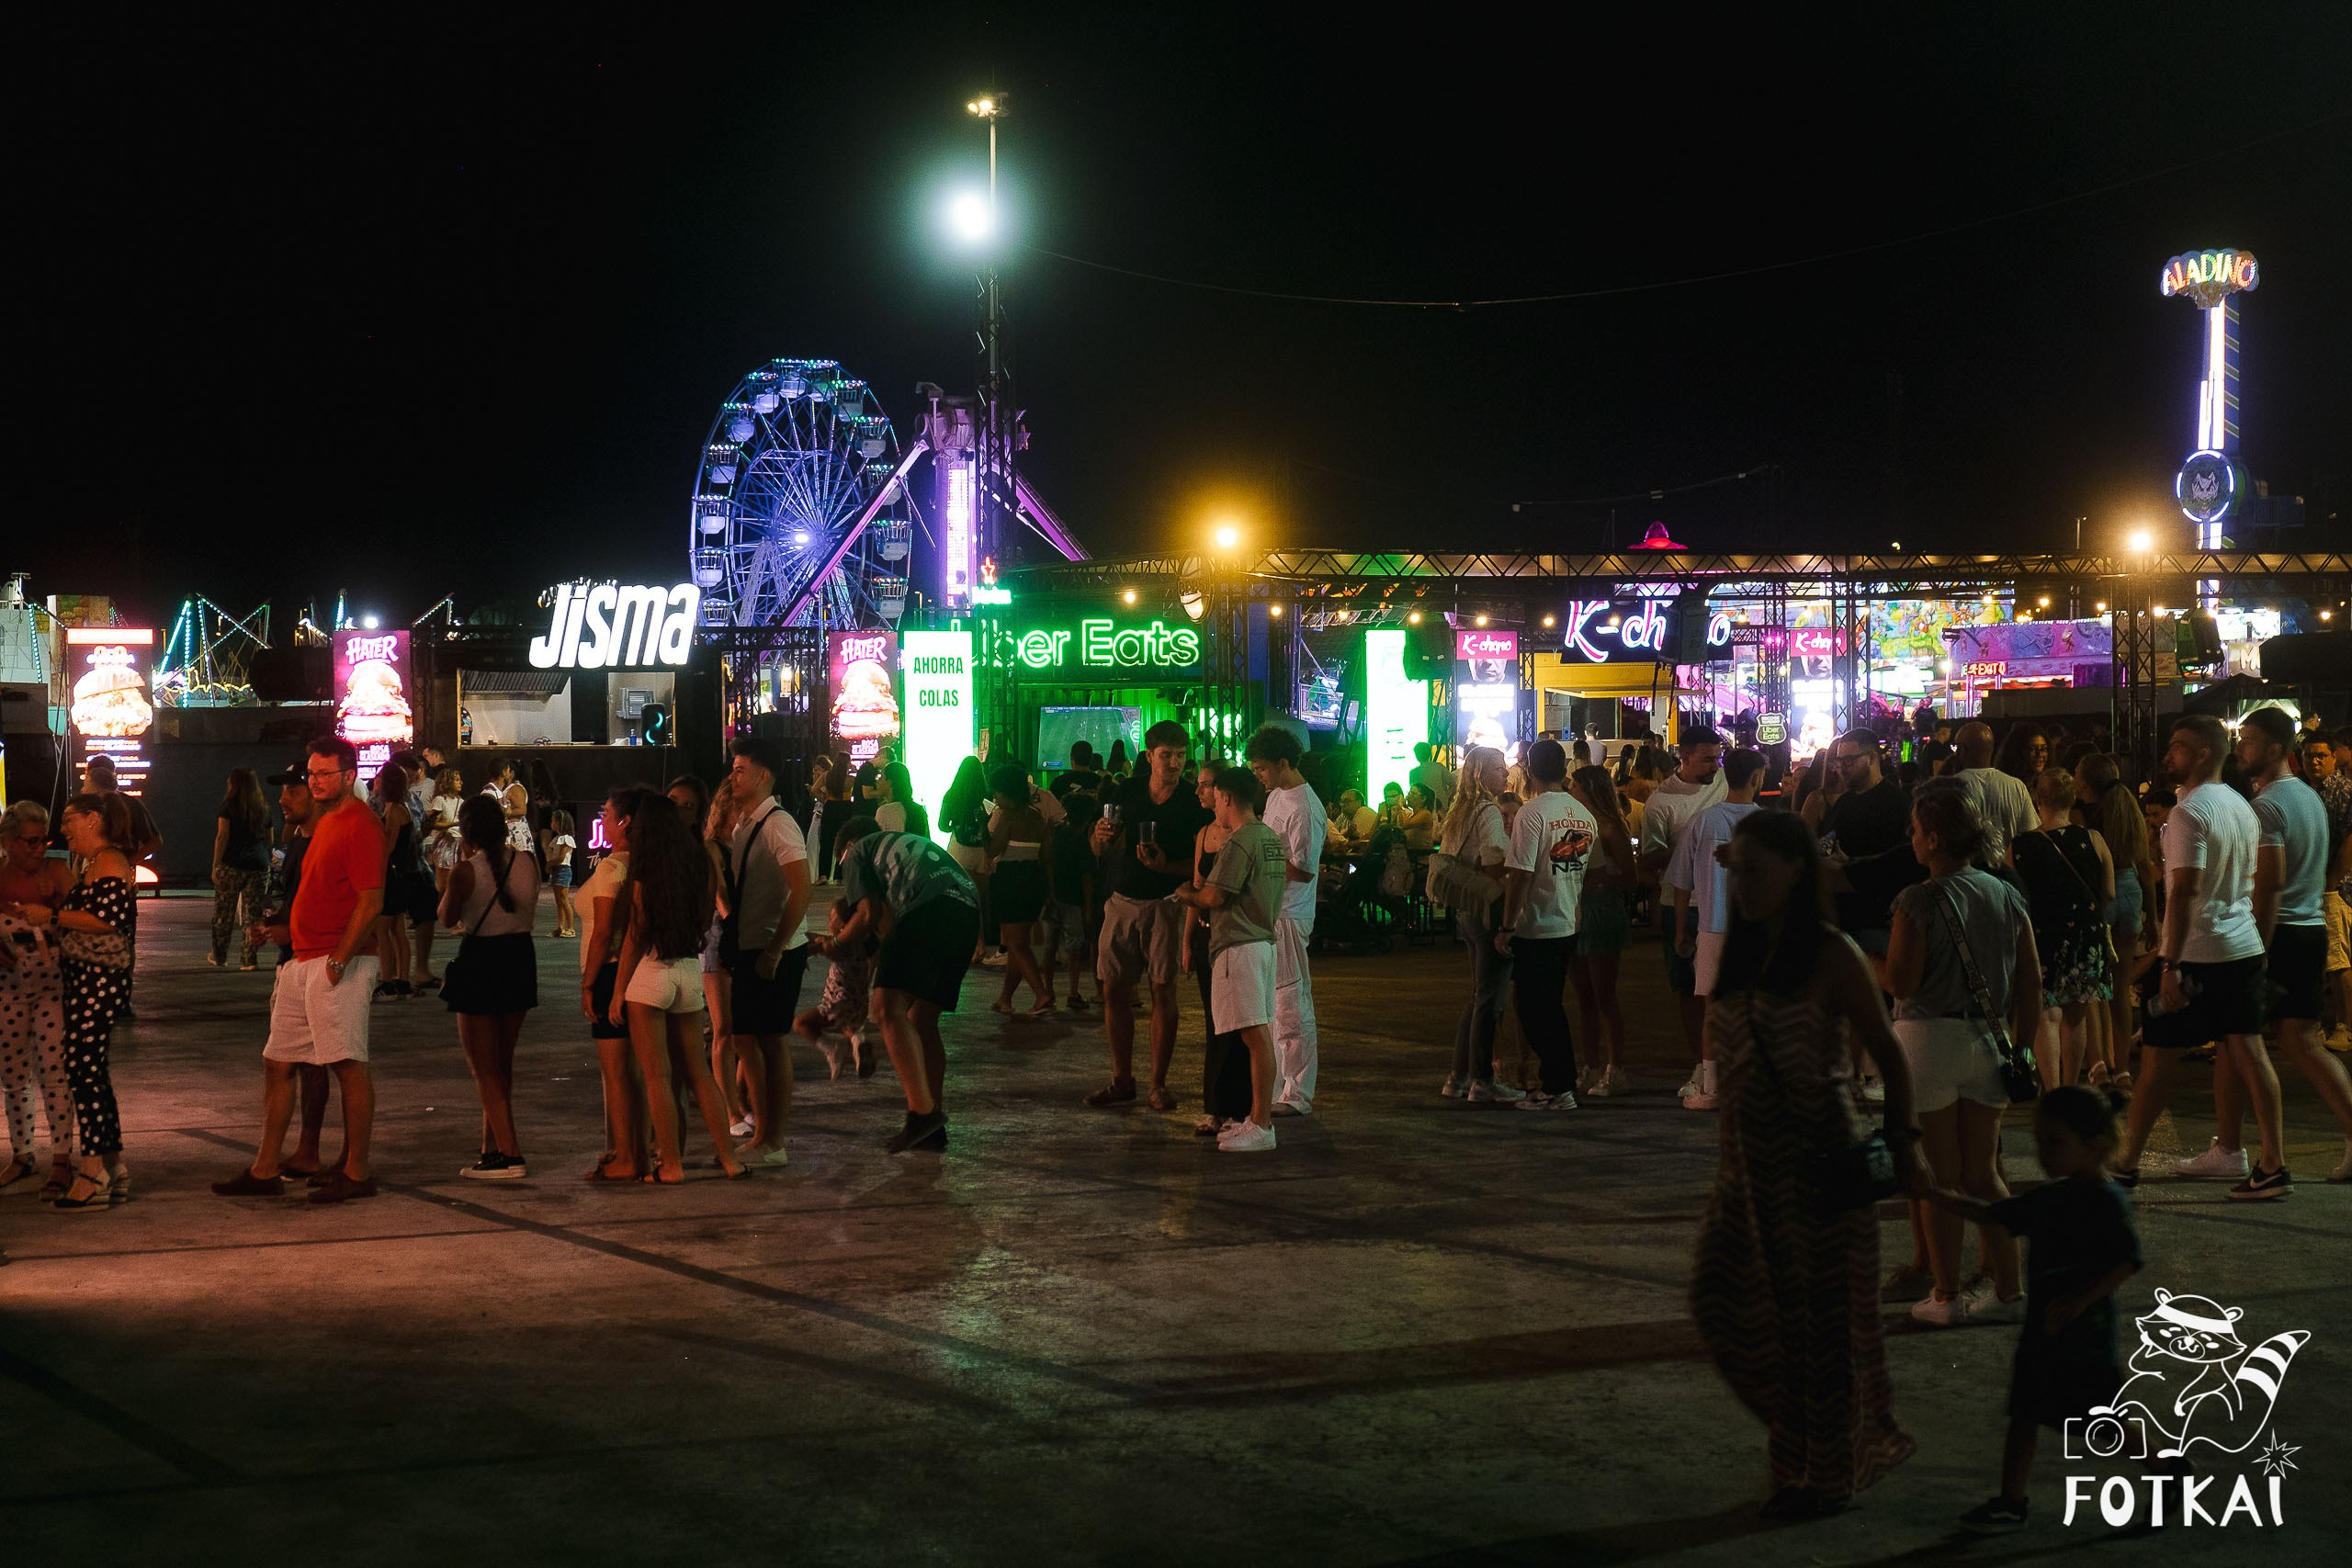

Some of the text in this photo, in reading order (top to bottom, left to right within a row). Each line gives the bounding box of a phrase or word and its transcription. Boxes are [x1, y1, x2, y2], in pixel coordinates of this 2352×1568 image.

[2163, 253, 2256, 296] ALADINO
[528, 582, 701, 670] Jisma
[345, 635, 400, 665] HATER
[840, 636, 888, 665] HATER
[1081, 618, 1200, 667] Eats
[913, 657, 964, 674] AHORRA
[919, 689, 959, 707] COLAS
[1549, 818, 1593, 832] HONDA
